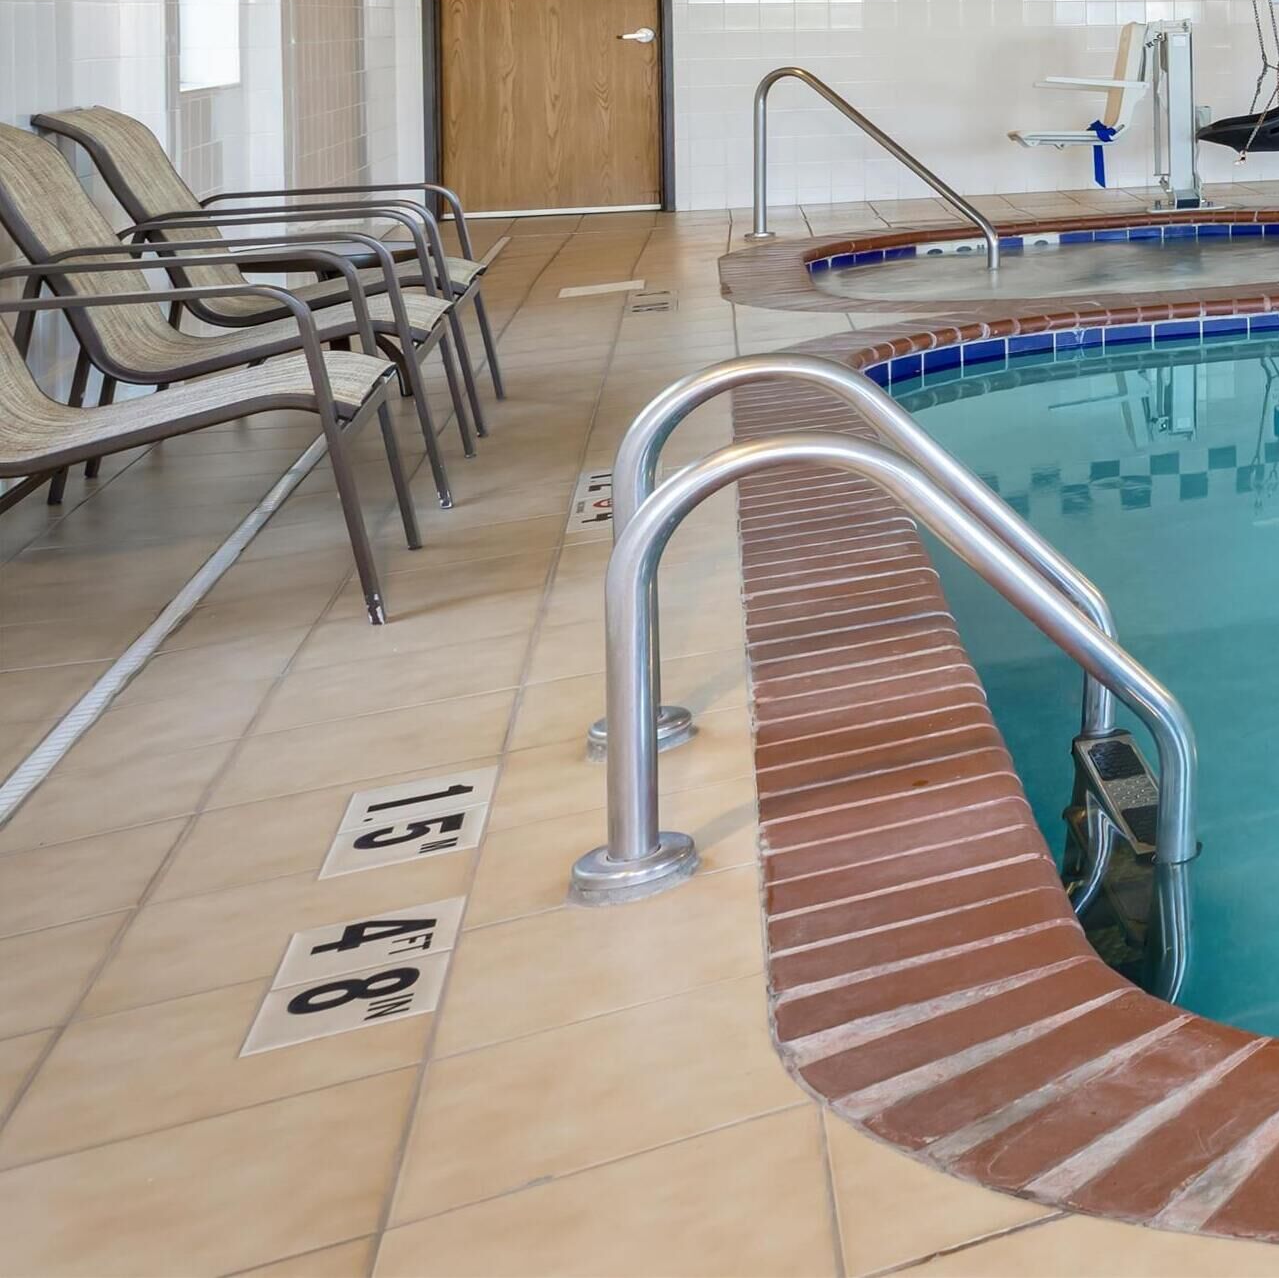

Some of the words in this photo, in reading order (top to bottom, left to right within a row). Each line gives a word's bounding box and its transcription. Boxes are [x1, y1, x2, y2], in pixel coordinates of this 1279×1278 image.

[353, 784, 474, 849] 1.5
[310, 919, 437, 955] 4
[388, 932, 433, 955] FT
[287, 967, 420, 1015] 8
[363, 993, 415, 1021] IN
